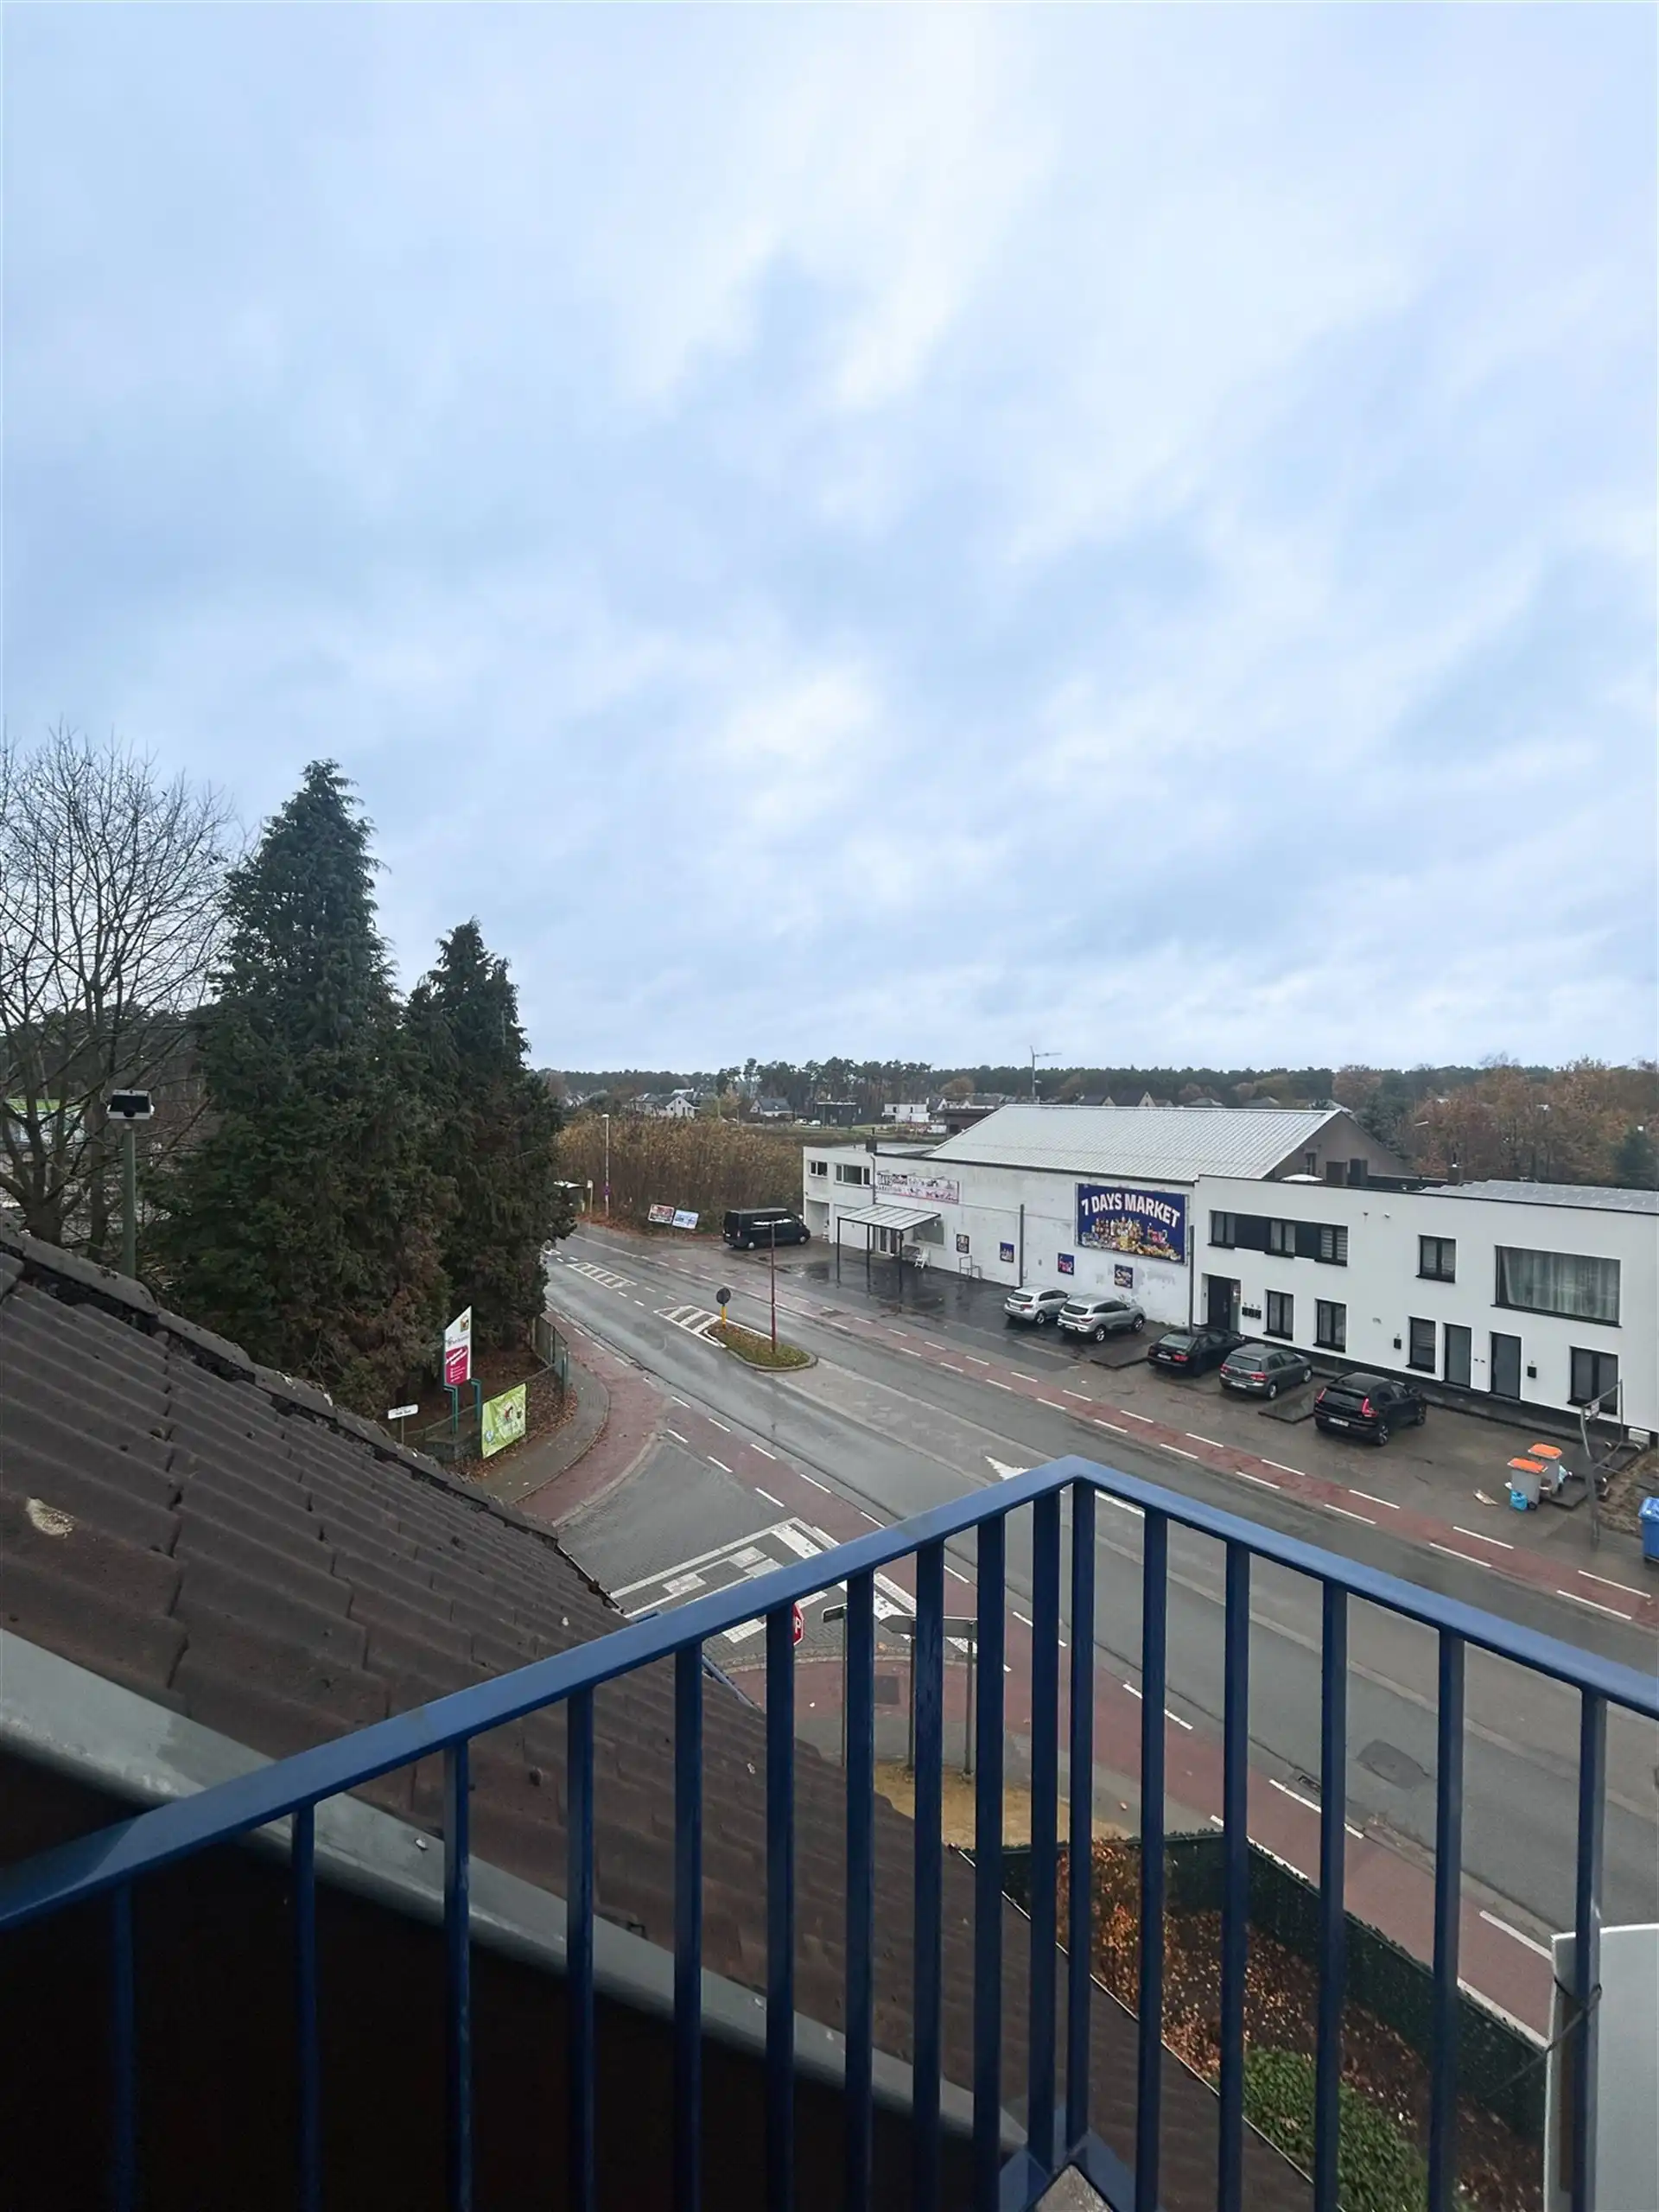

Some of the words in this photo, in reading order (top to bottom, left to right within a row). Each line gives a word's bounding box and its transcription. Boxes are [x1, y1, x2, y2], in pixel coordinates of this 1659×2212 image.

[1081, 1198, 1089, 1216] 7
[1091, 1192, 1122, 1213] DAYS
[1124, 1193, 1180, 1228] MARKET
